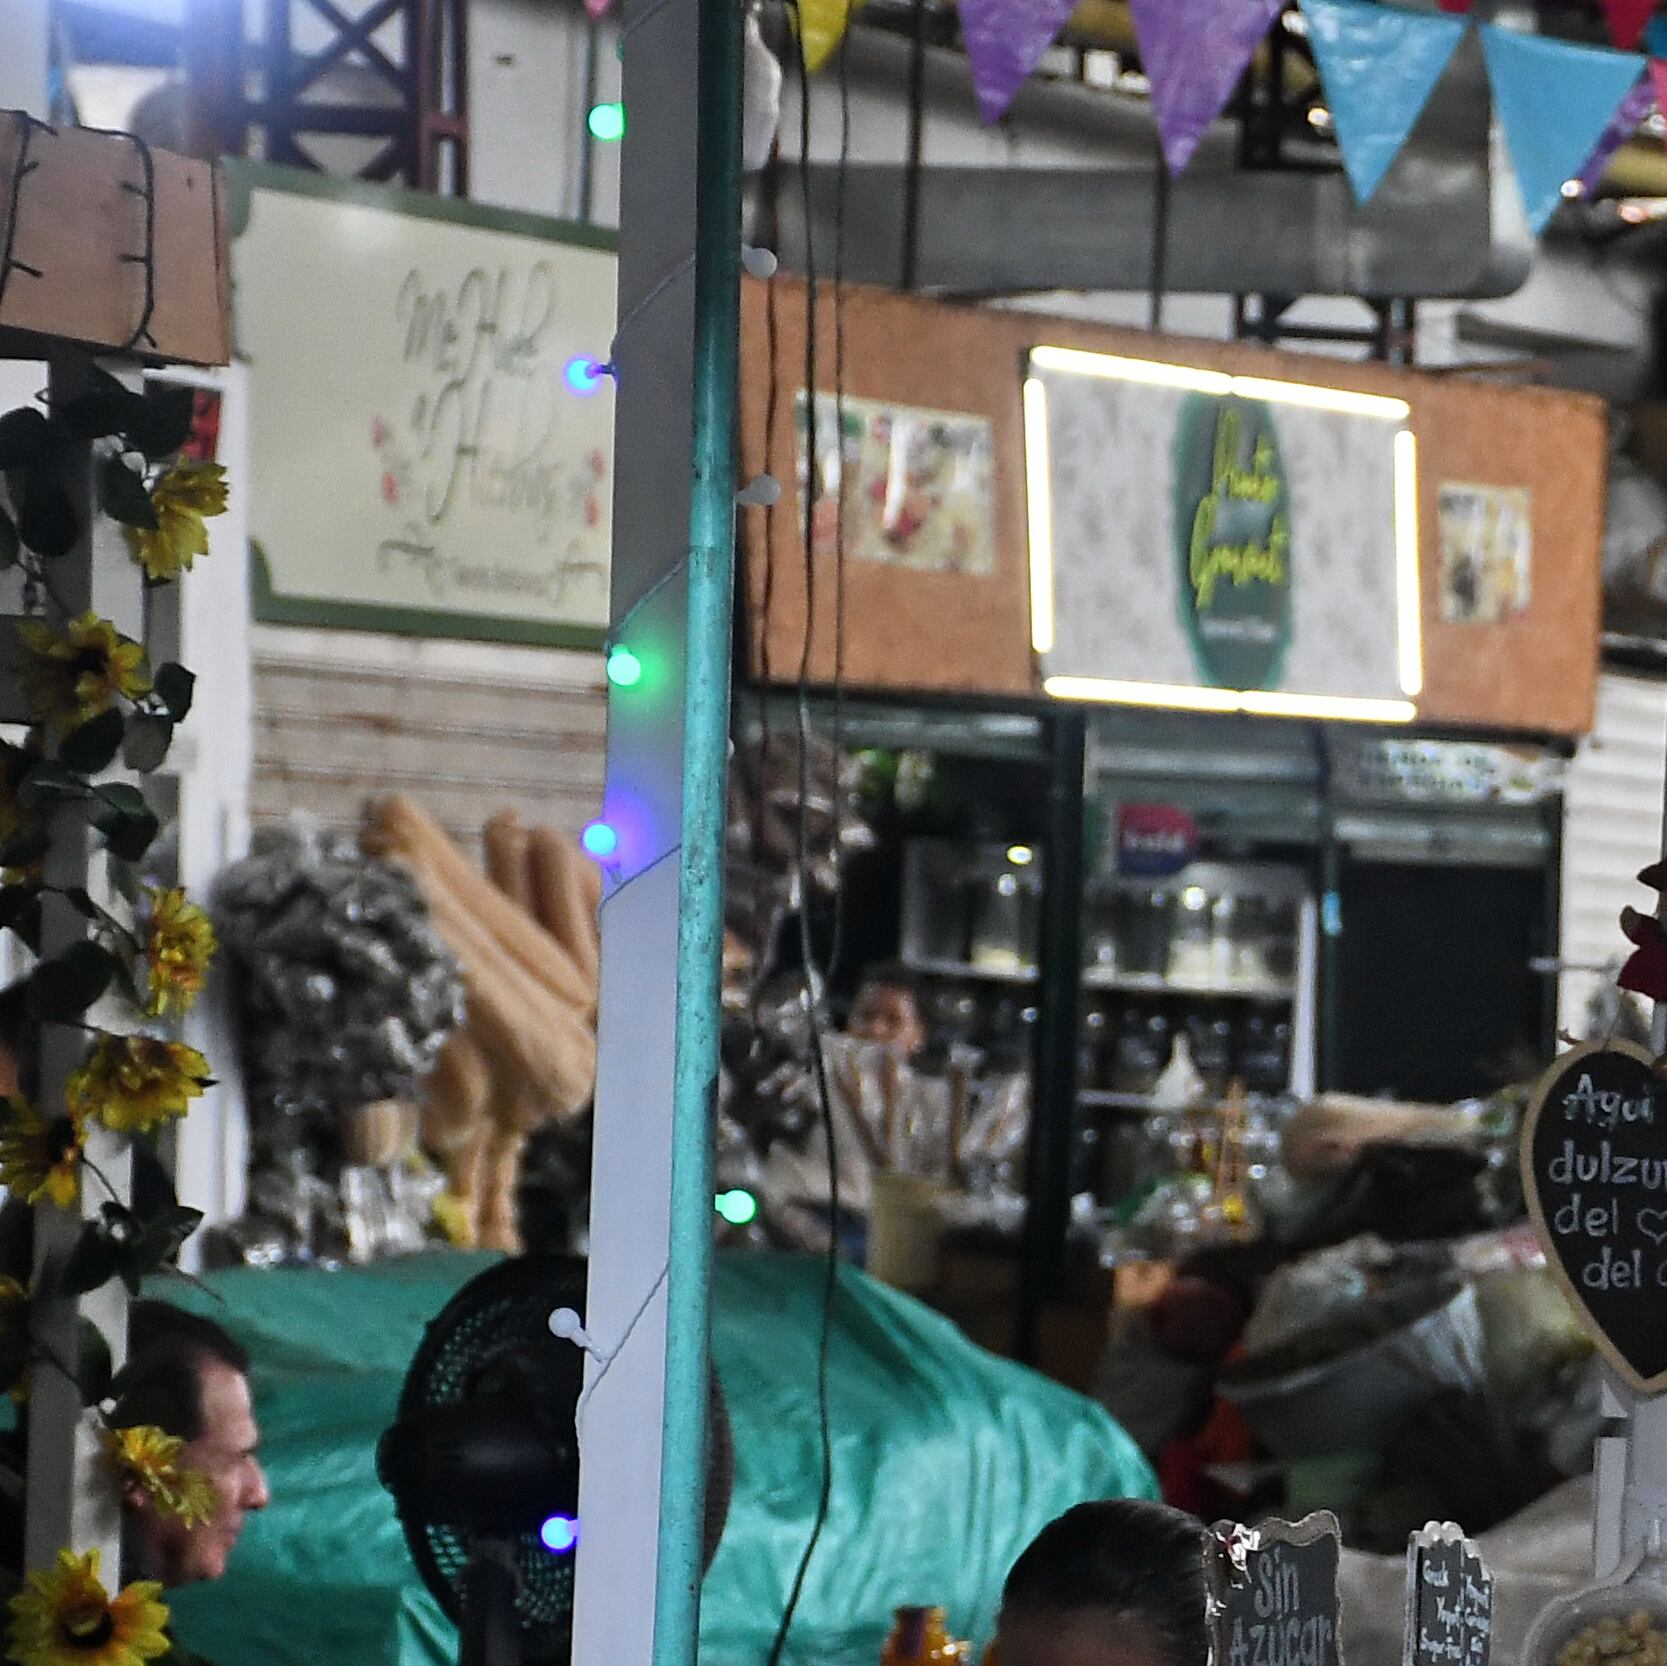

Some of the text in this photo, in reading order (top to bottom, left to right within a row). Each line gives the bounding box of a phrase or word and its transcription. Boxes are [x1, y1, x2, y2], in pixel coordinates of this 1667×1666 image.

[1554, 1193, 1619, 1236] del
[1583, 1247, 1642, 1291] del
[1255, 1547, 1300, 1618] Sin
